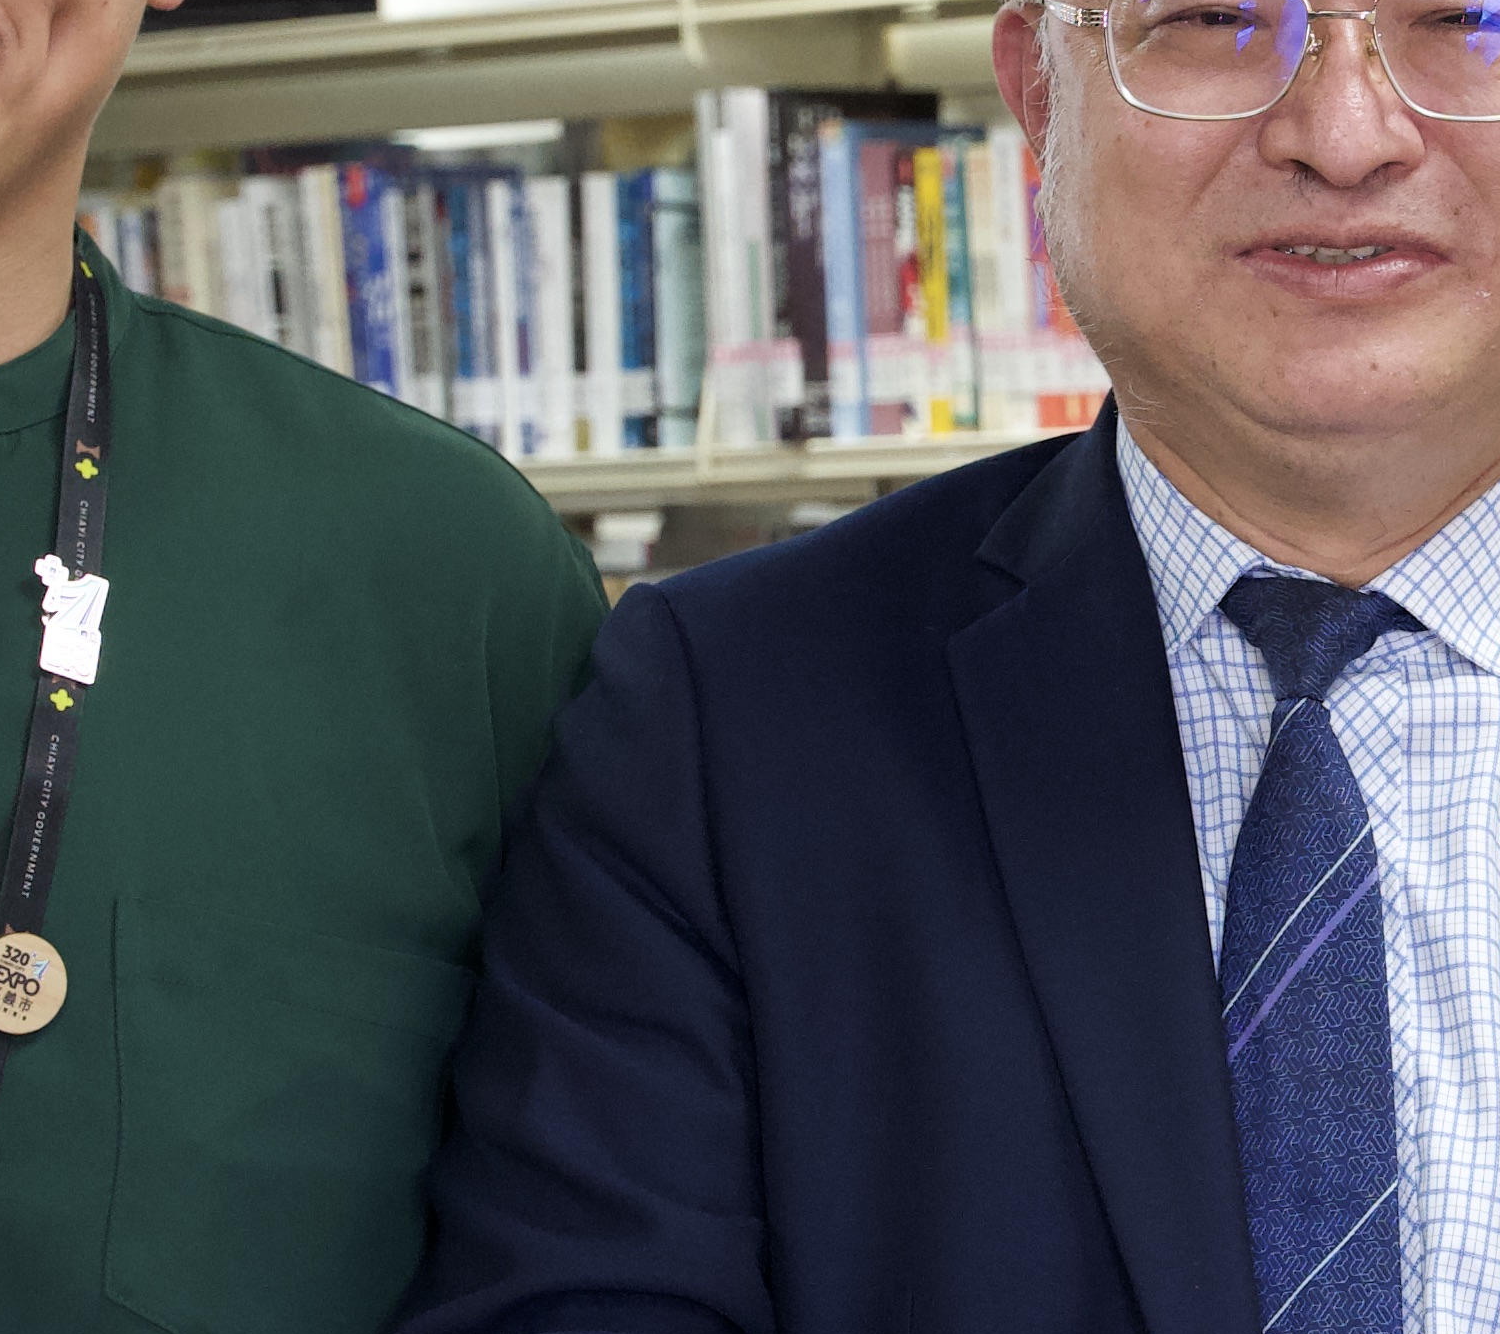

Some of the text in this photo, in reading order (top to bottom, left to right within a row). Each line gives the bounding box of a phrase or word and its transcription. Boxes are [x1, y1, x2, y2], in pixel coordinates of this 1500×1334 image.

[77, 499, 90, 539] CHIAYI
[76, 541, 87, 567] CITY
[21, 734, 60, 899] CHIAYI CITY GOVERNMENT
[2, 945, 31, 966] 320
